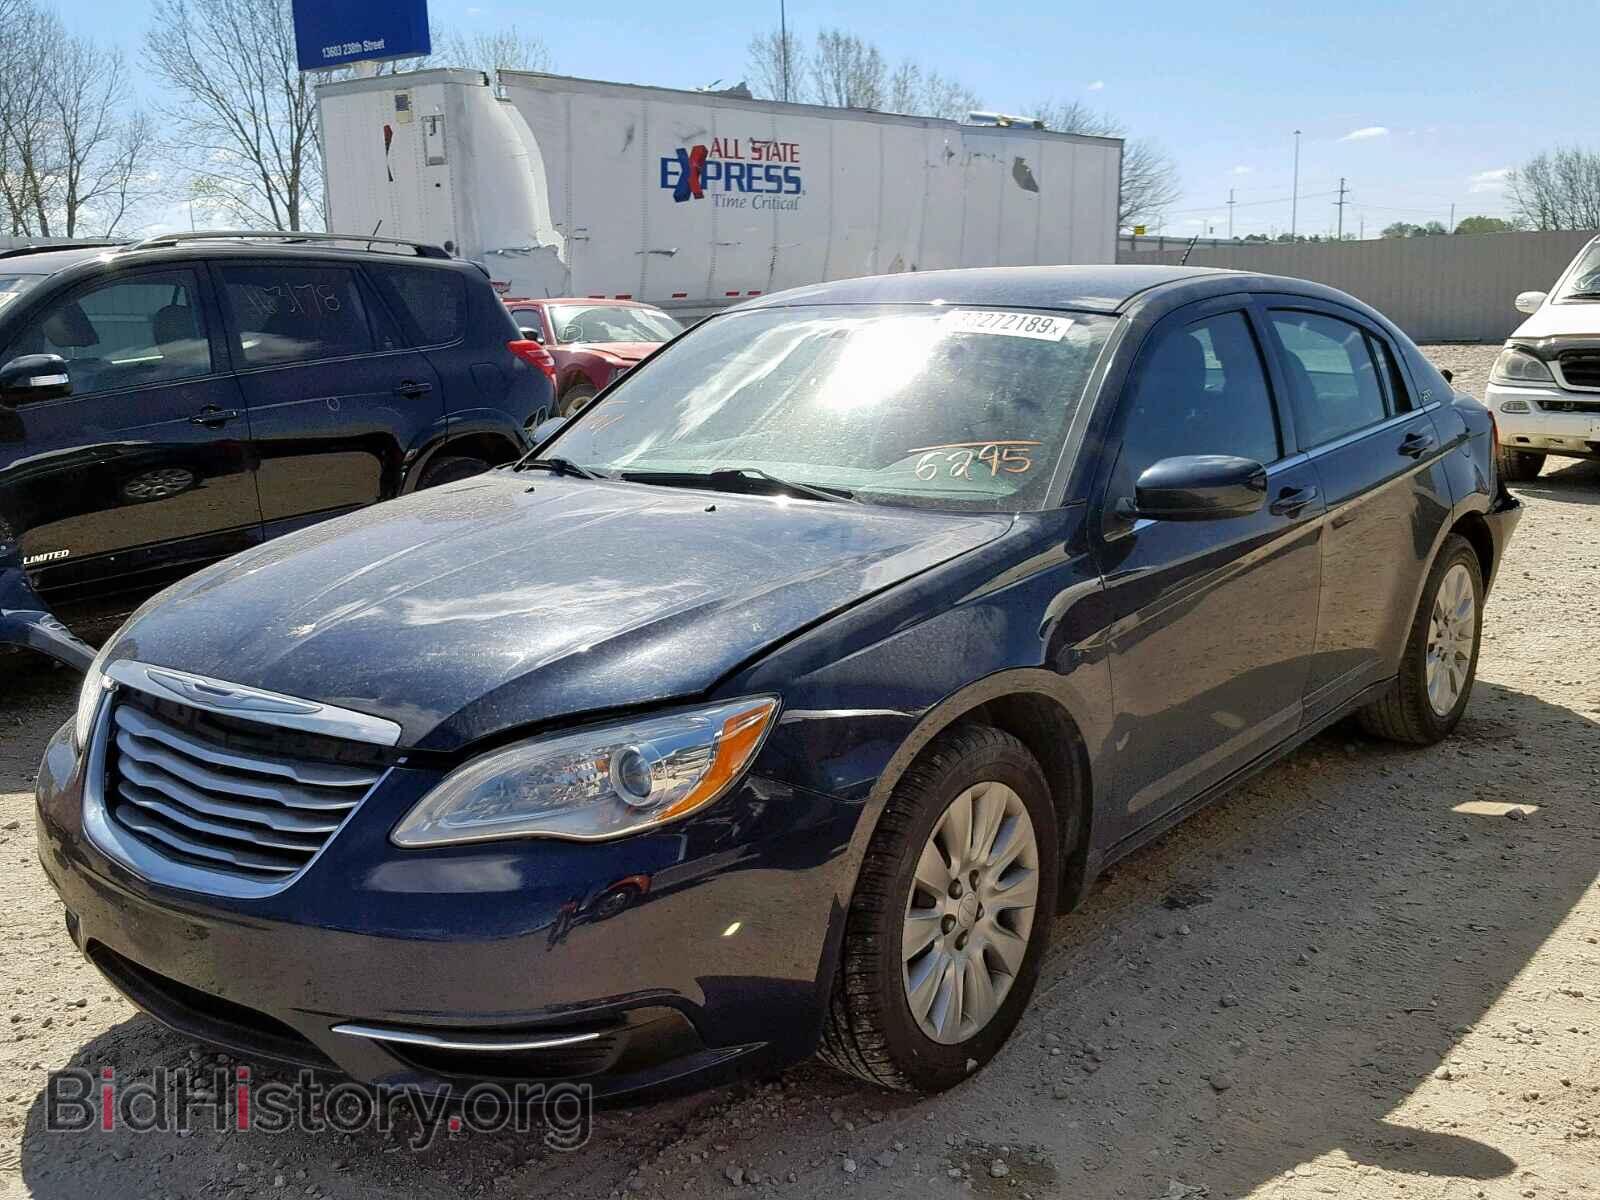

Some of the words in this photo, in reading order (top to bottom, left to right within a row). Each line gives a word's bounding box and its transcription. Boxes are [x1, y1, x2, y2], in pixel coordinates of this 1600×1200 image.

[363, 38, 385, 52] Street
[709, 137, 745, 160] ALL
[751, 140, 800, 163] STATE
[660, 145, 802, 203] EXPRESS
[712, 193, 747, 209] Time
[752, 193, 802, 211] Critical
[915, 443, 1032, 481] 6295
[23, 549, 70, 565] LIMITED
